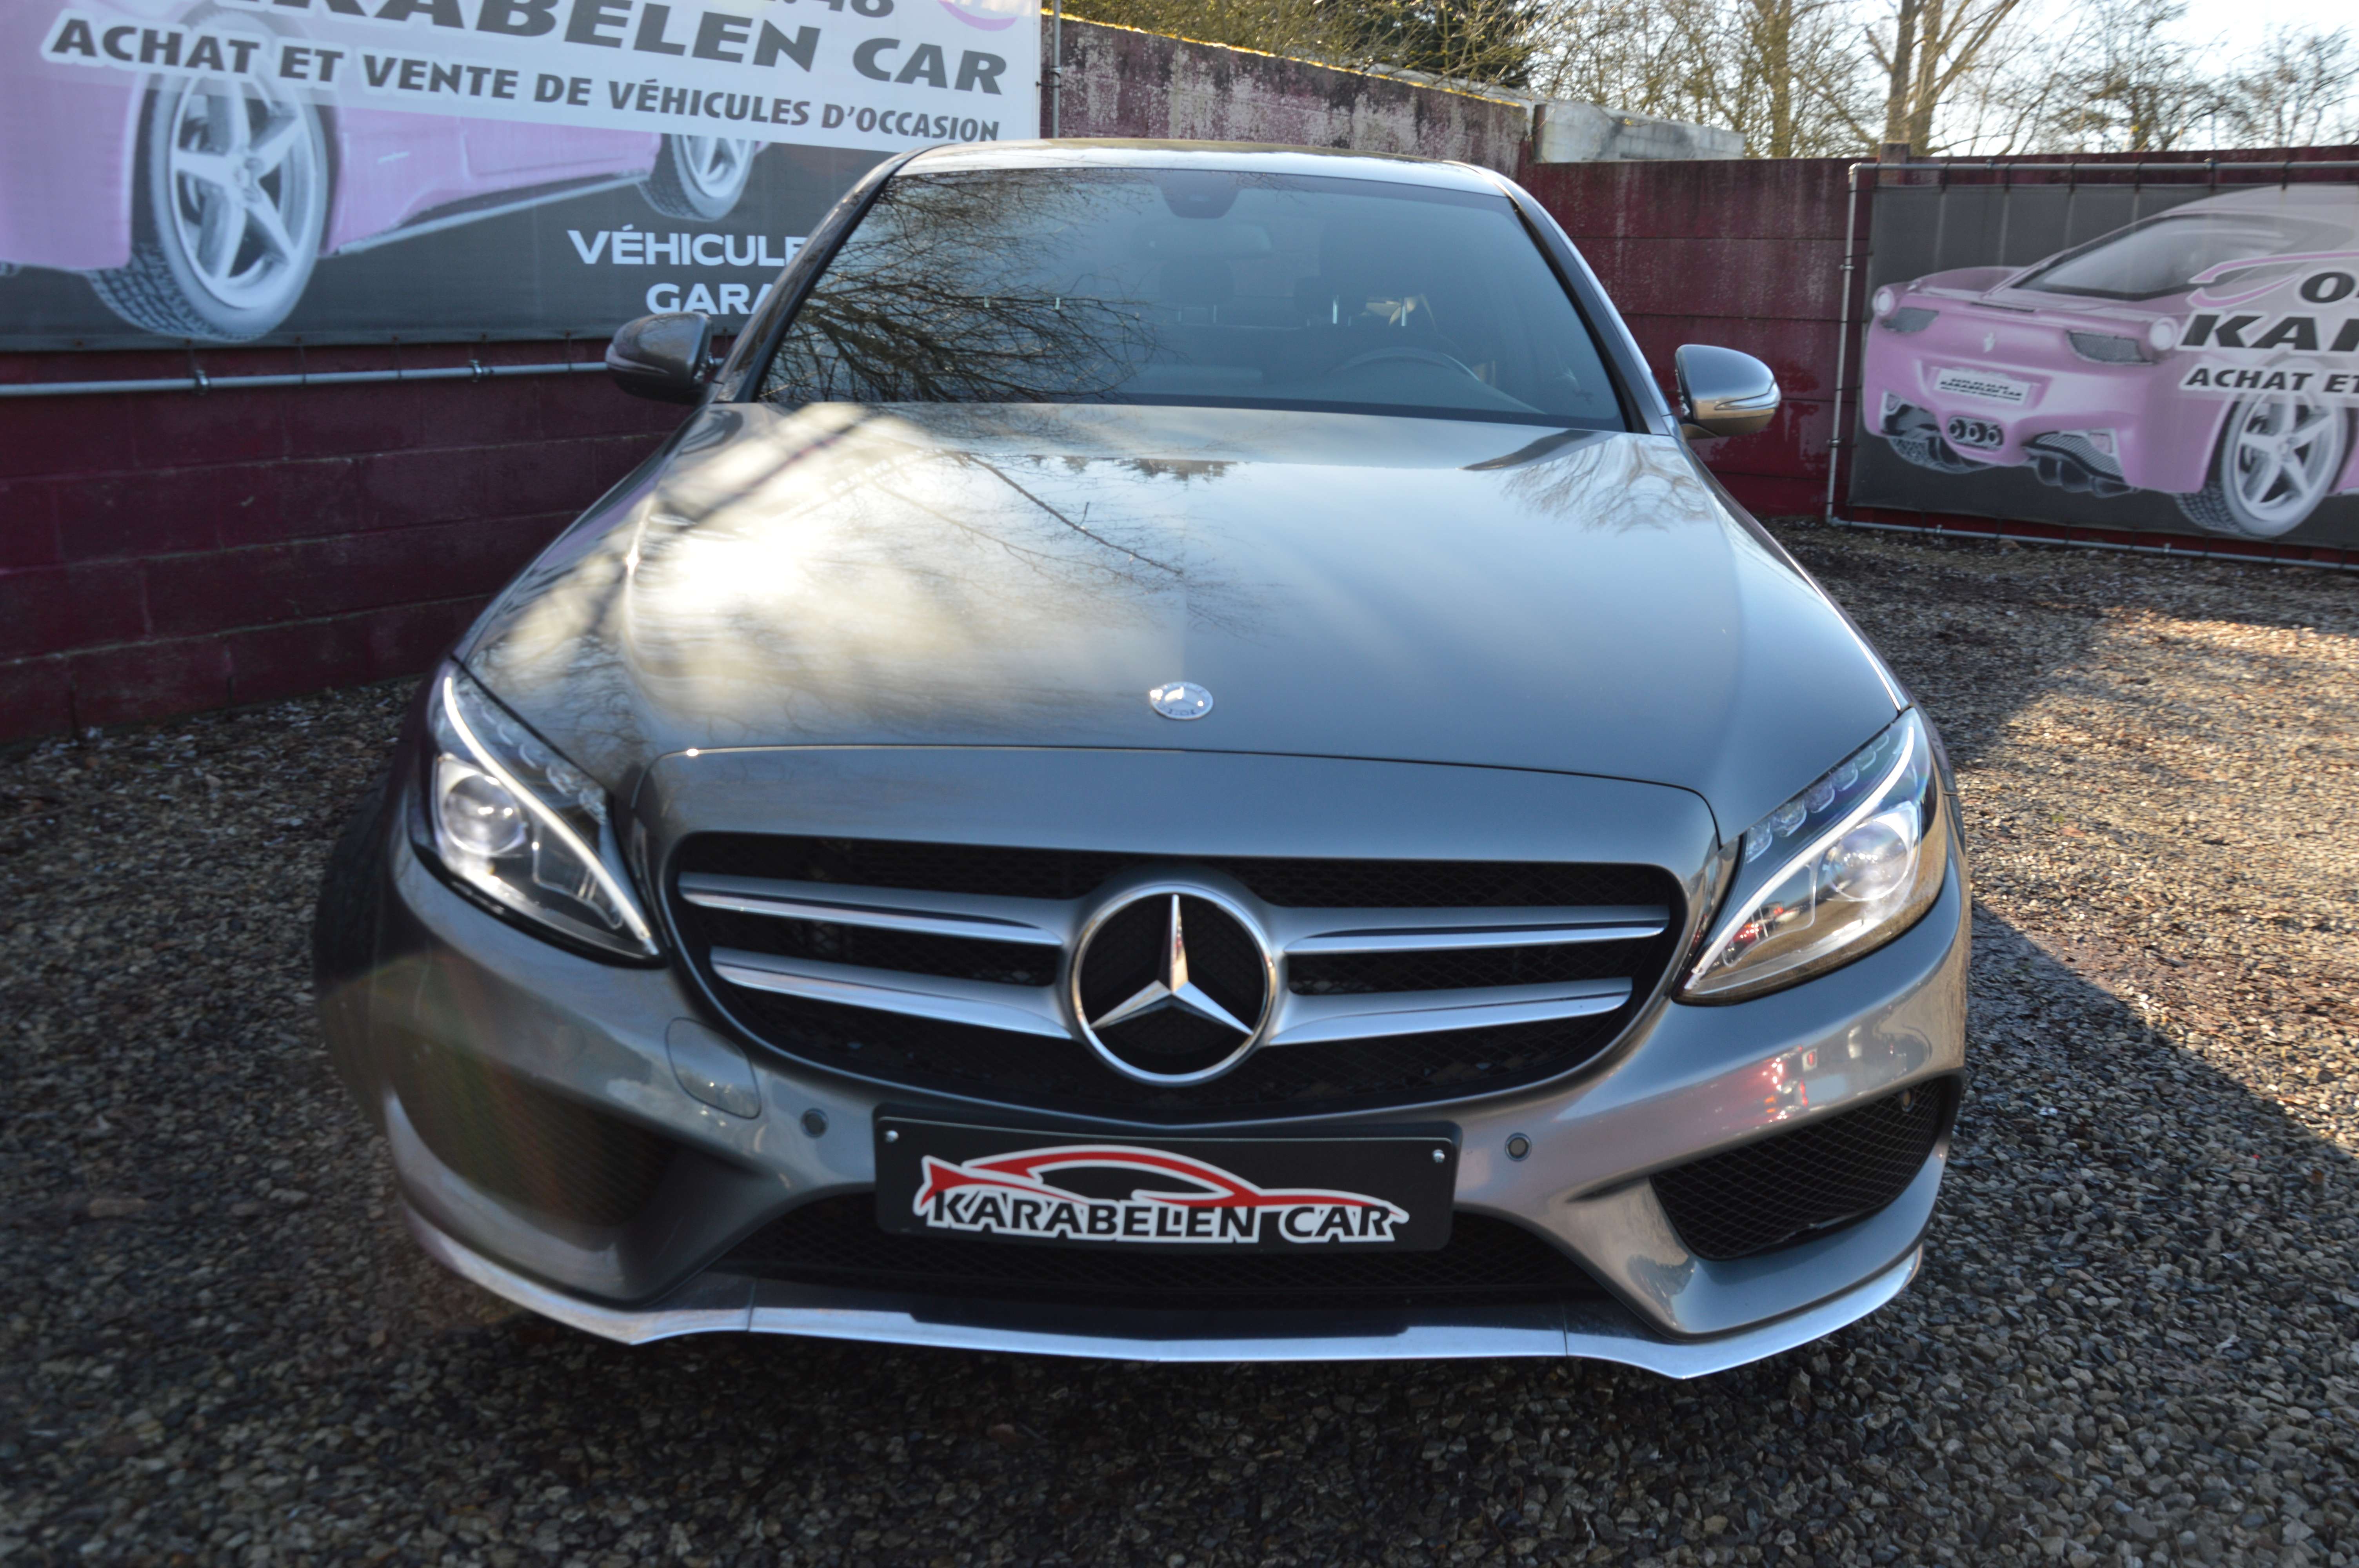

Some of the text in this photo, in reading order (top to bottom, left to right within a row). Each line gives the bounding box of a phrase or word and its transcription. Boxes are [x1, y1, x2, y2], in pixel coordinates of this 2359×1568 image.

[51, 19, 1000, 142] ACHAT ET VENTE DE VÉHICULES D'OCCASION
[853, 38, 1007, 95] CAR
[2185, 368, 2313, 391] ACHAT
[933, 1191, 1391, 1238] KARABELEN CAR
